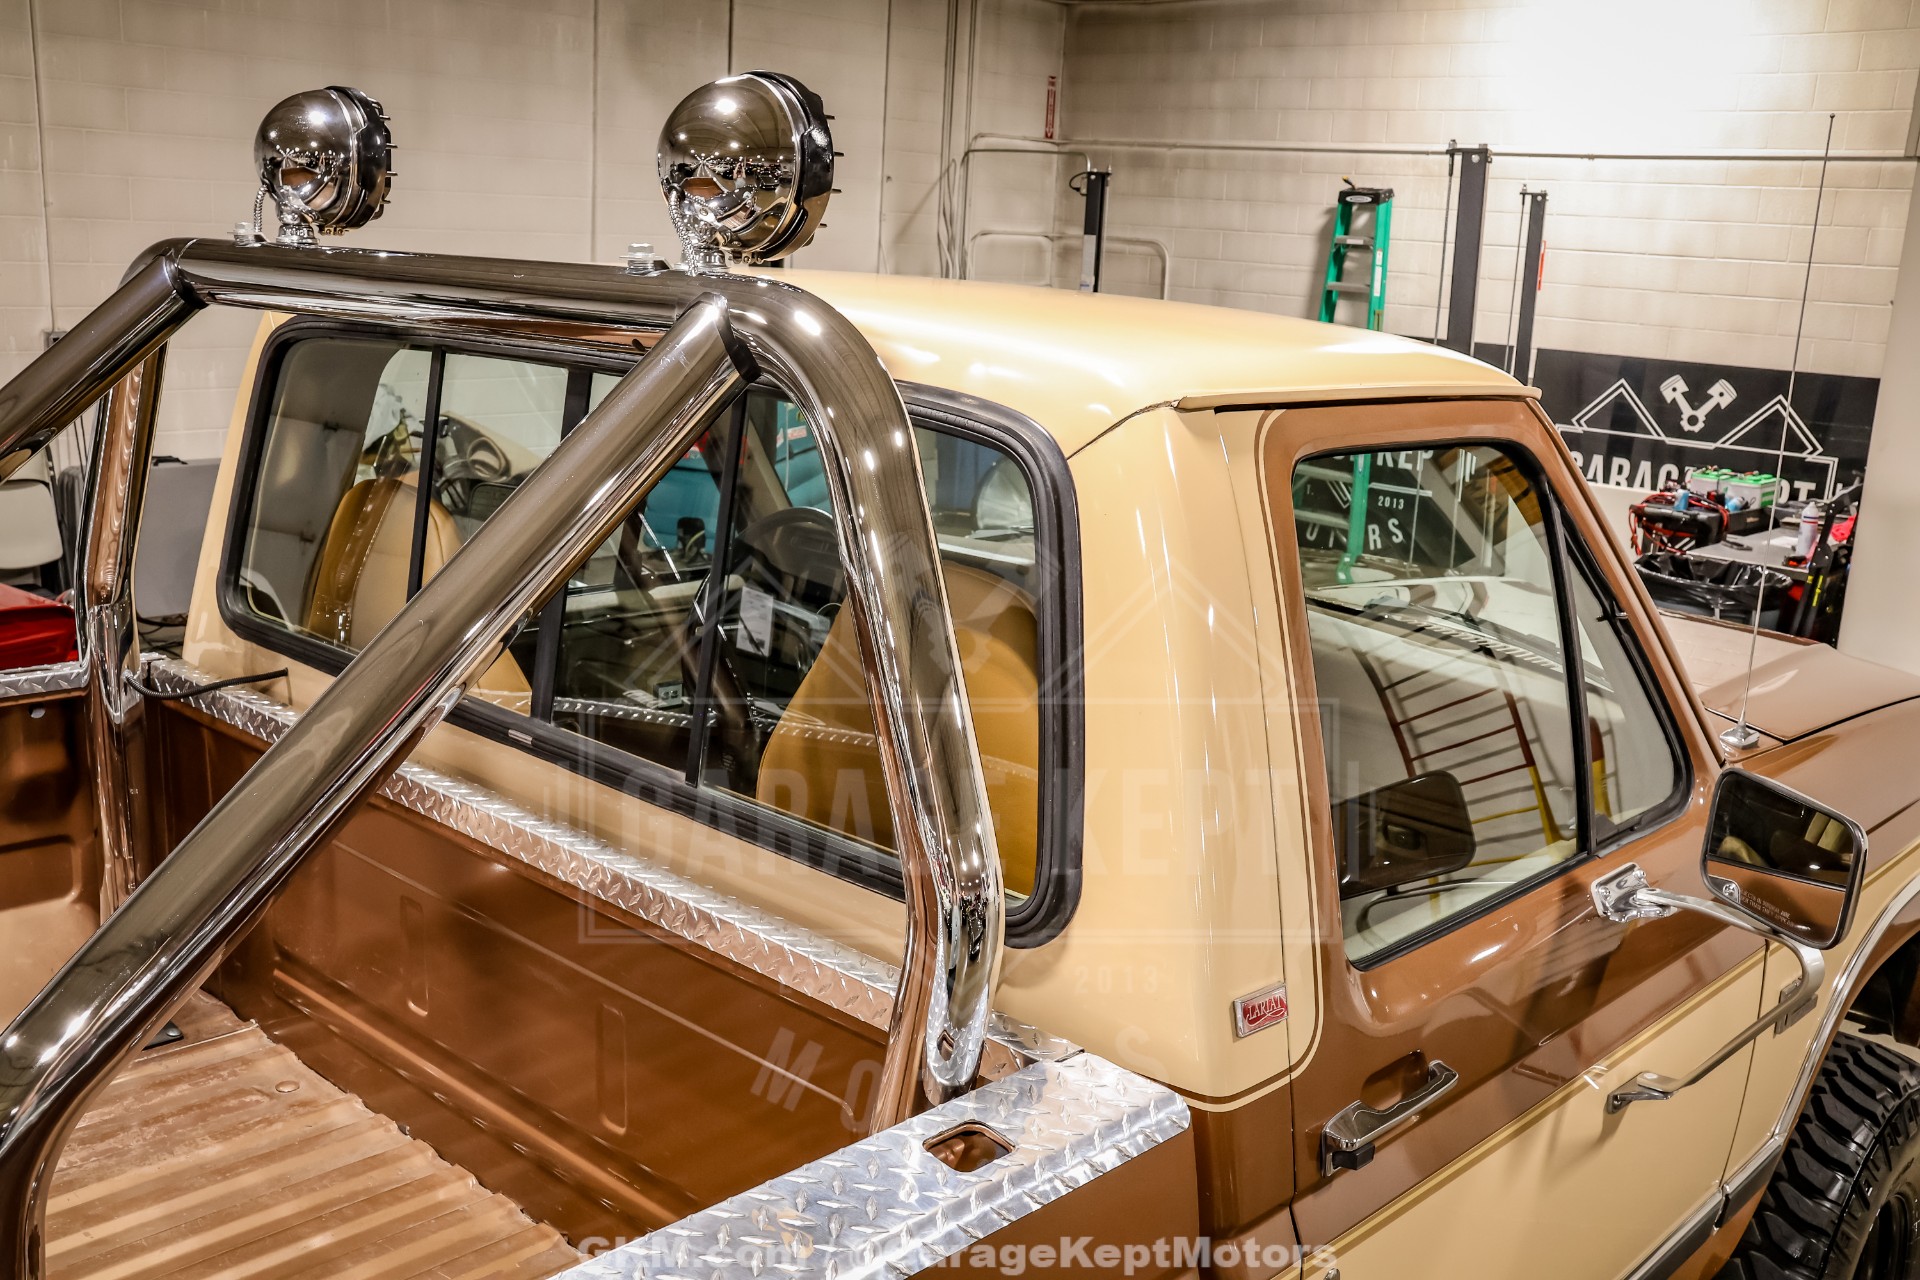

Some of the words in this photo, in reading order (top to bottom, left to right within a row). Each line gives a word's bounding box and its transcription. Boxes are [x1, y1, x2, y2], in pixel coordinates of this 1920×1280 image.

[1570, 450, 1697, 491] ARAG
[1377, 495, 1405, 510] 2013
[1246, 995, 1283, 1021] LARIAT
